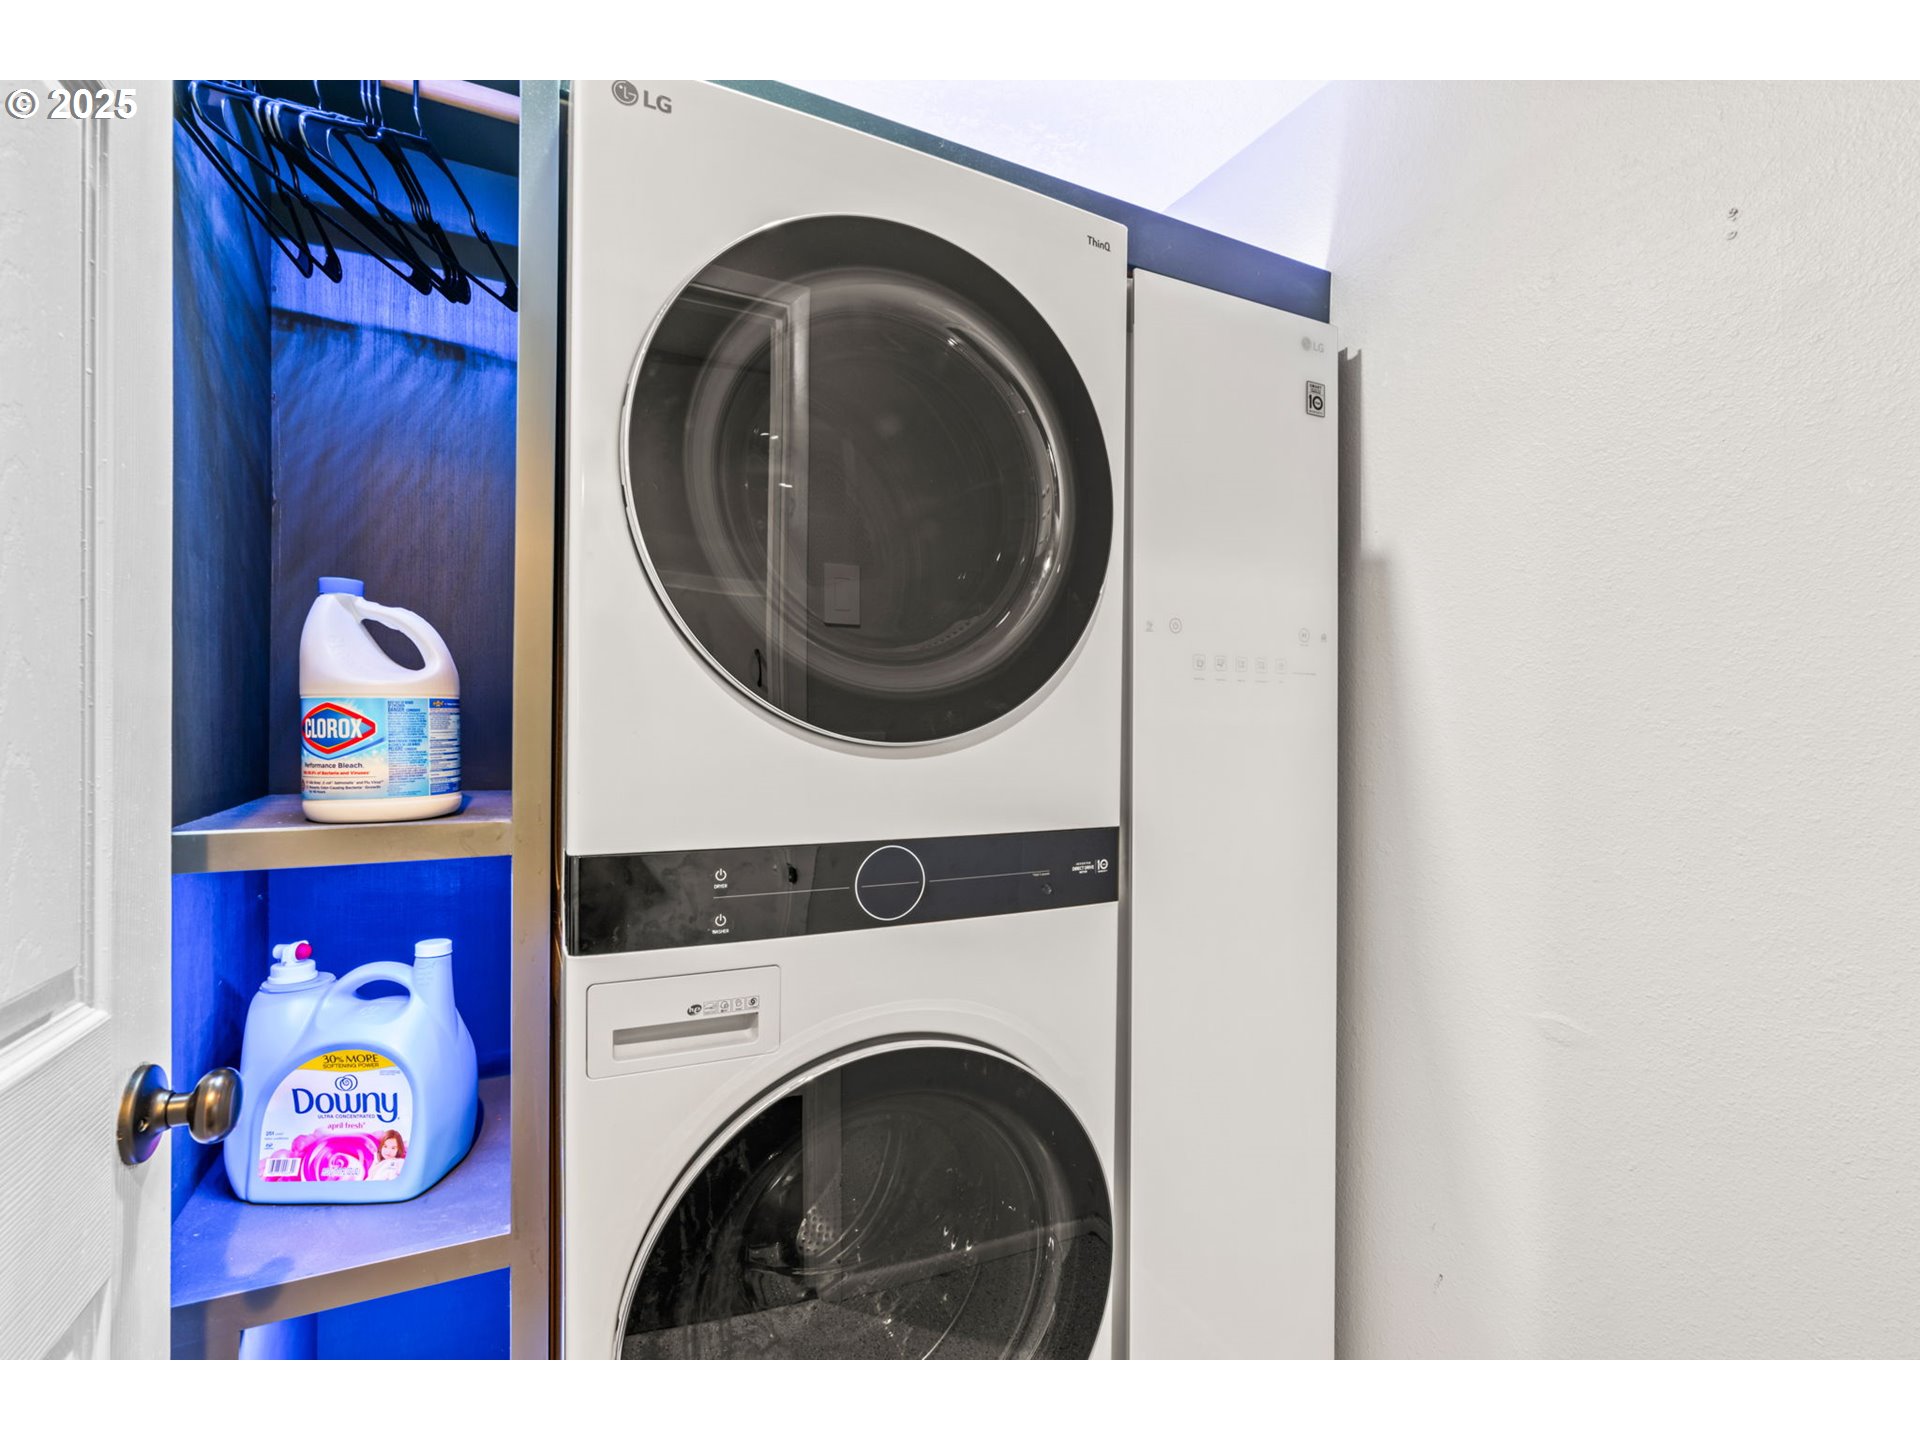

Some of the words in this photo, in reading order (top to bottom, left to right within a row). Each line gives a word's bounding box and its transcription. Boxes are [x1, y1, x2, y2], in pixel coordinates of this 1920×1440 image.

[643, 89, 673, 114] LG
[1087, 234, 1111, 252] ThinQ
[1312, 341, 1325, 354] LG
[304, 718, 363, 739] CLOROX
[322, 1054, 344, 1063] 30%
[345, 1053, 379, 1063] MORE
[292, 1088, 398, 1123] Downy
[327, 1122, 344, 1130] april
